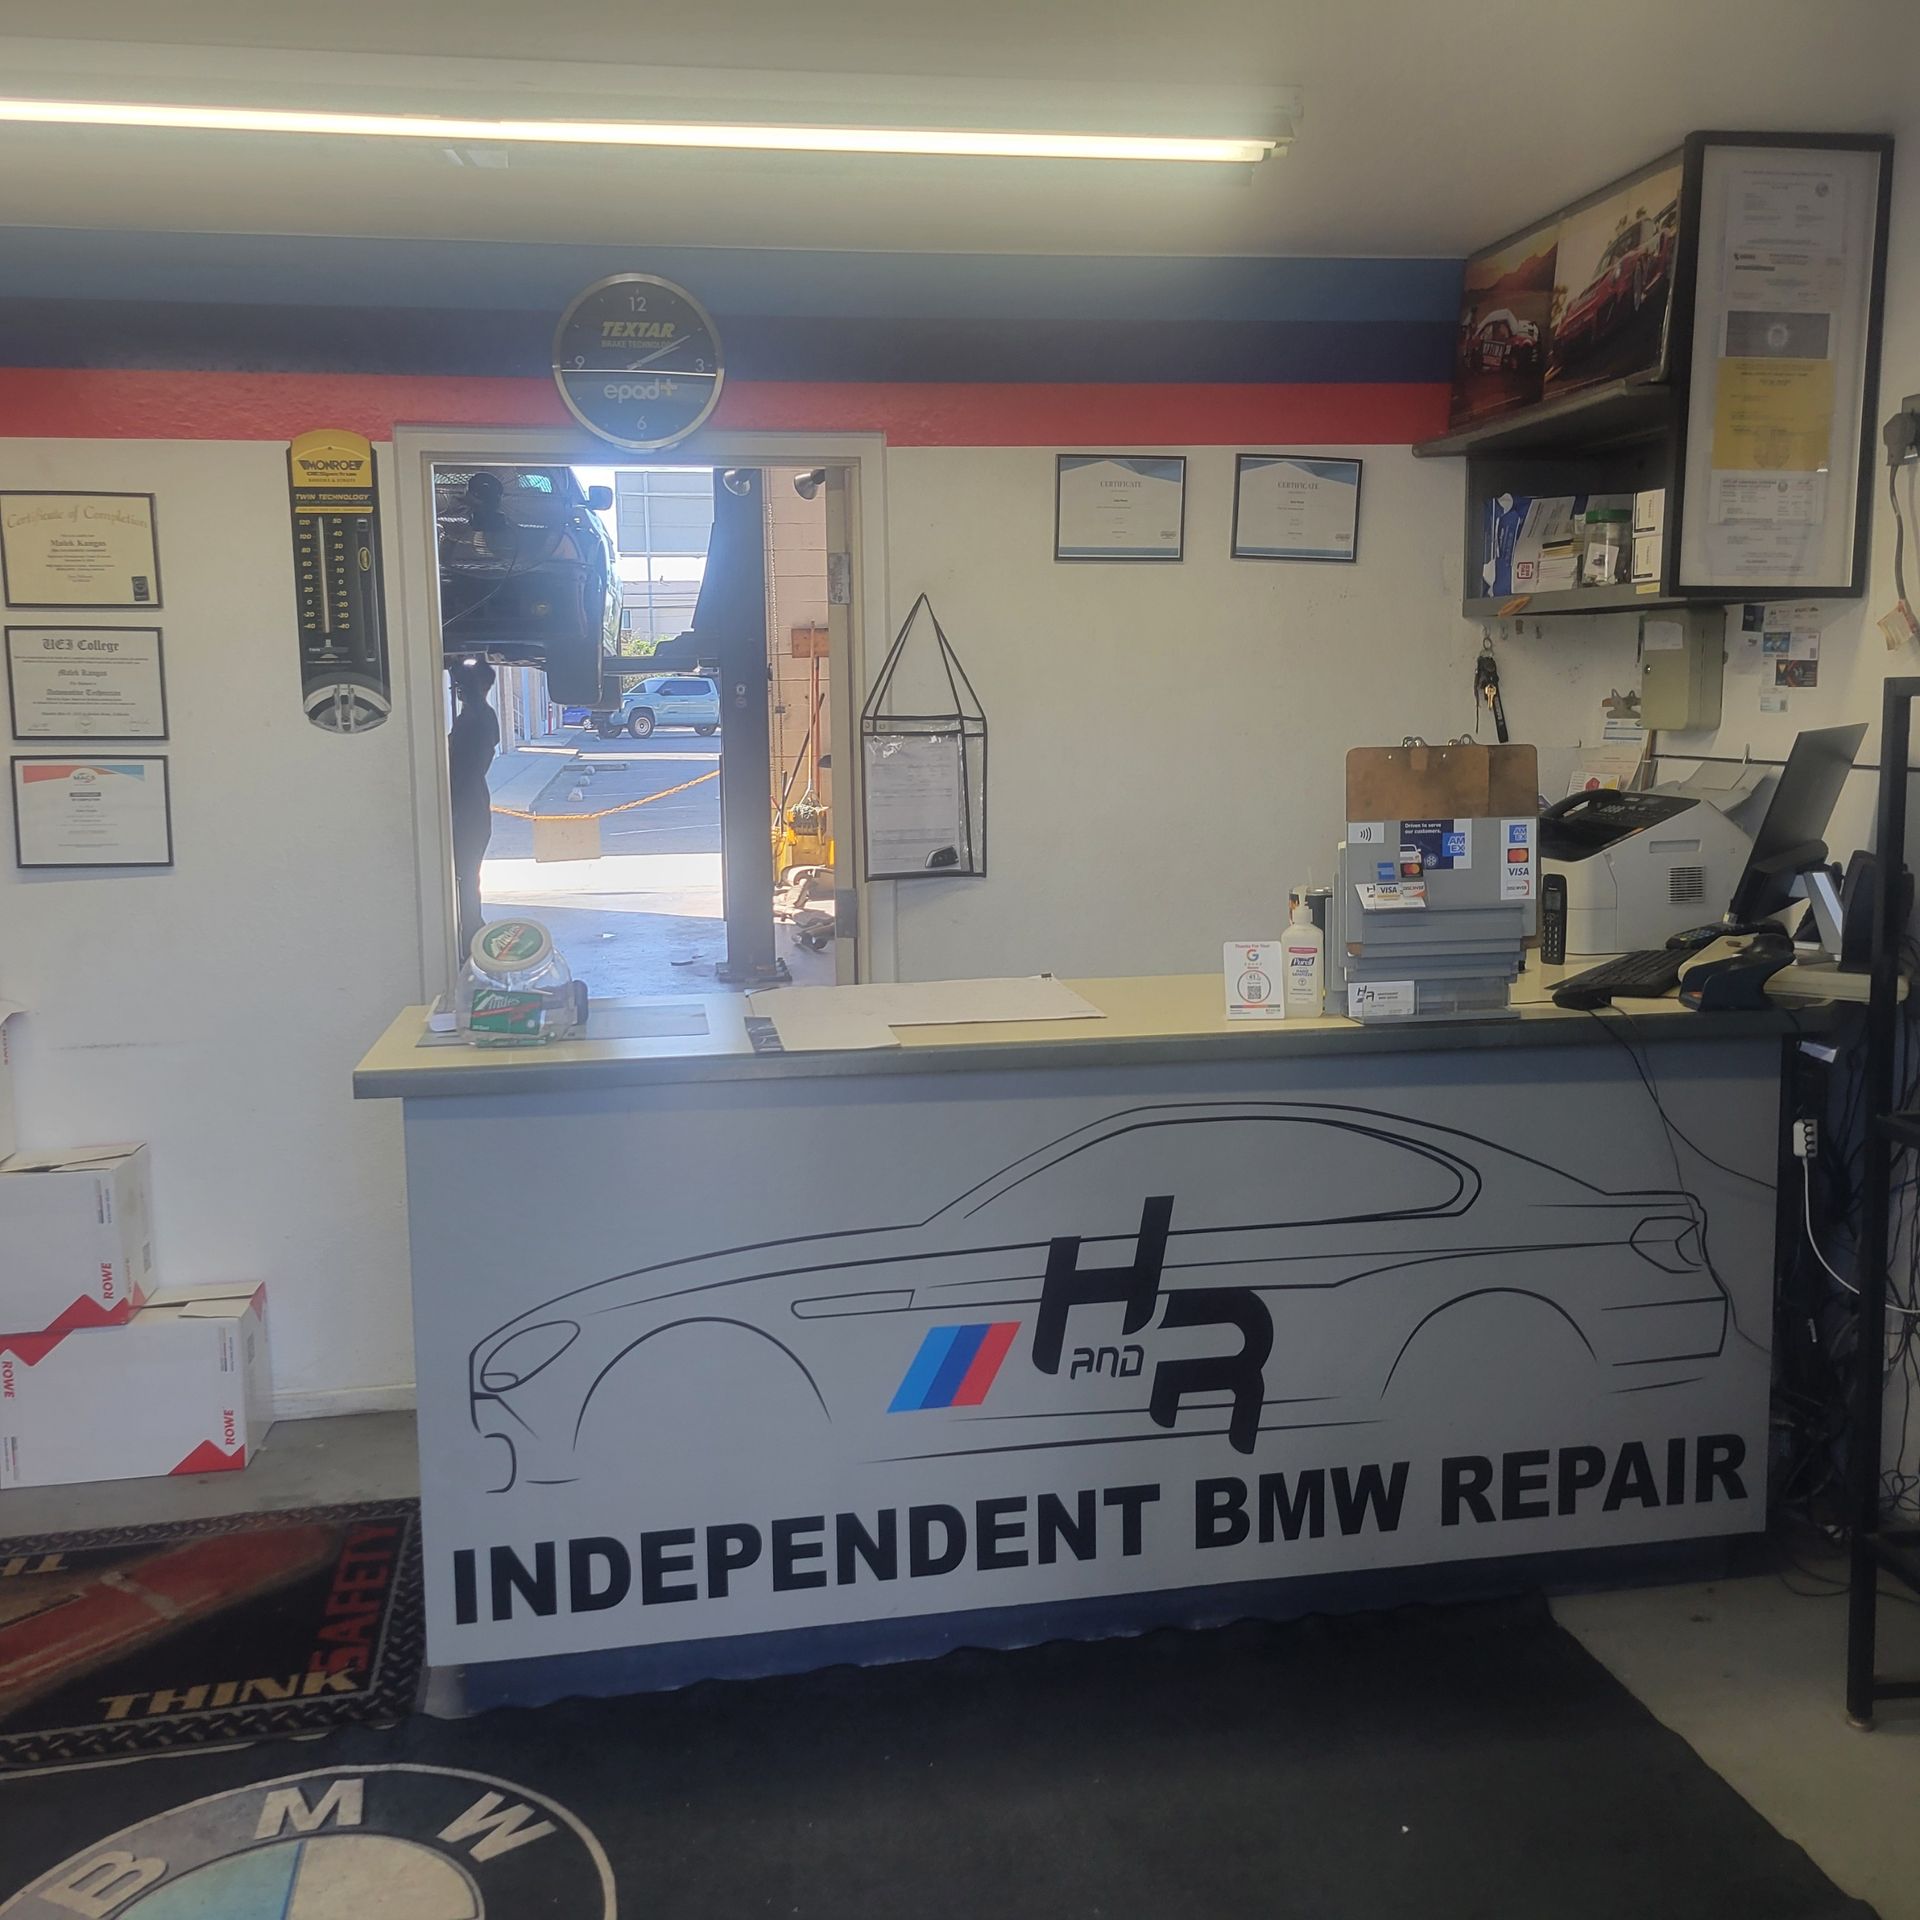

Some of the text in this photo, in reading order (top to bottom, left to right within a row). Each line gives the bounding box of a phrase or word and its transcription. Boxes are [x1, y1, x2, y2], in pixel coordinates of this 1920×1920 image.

[630, 297, 647, 312] 12
[601, 321, 676, 338] TEXTAR
[575, 355, 585, 369] 9
[695, 358, 705, 372] 3
[637, 416, 647, 430] 6
[298, 459, 364, 471] MONROE
[1277, 481, 1318, 490] CERTIFICATE
[77, 640, 120, 653] College
[1448, 836, 1465, 845] AM
[1508, 868, 1530, 876] VISA
[101, 1262, 113, 1300] ROWE
[1032, 1195, 1175, 1375] H
[1070, 1344, 1145, 1380] AND
[1148, 1288, 1275, 1455] R
[2, 1361, 15, 1398] ROWE
[224, 1409, 235, 1446] ROWE
[454, 1433, 1748, 1626] INDEPENDENT BMW REPAIR
[308, 1523, 398, 1673] SAFETY
[100, 1667, 360, 1720] THINK
[40, 1778, 557, 1918] BMW
